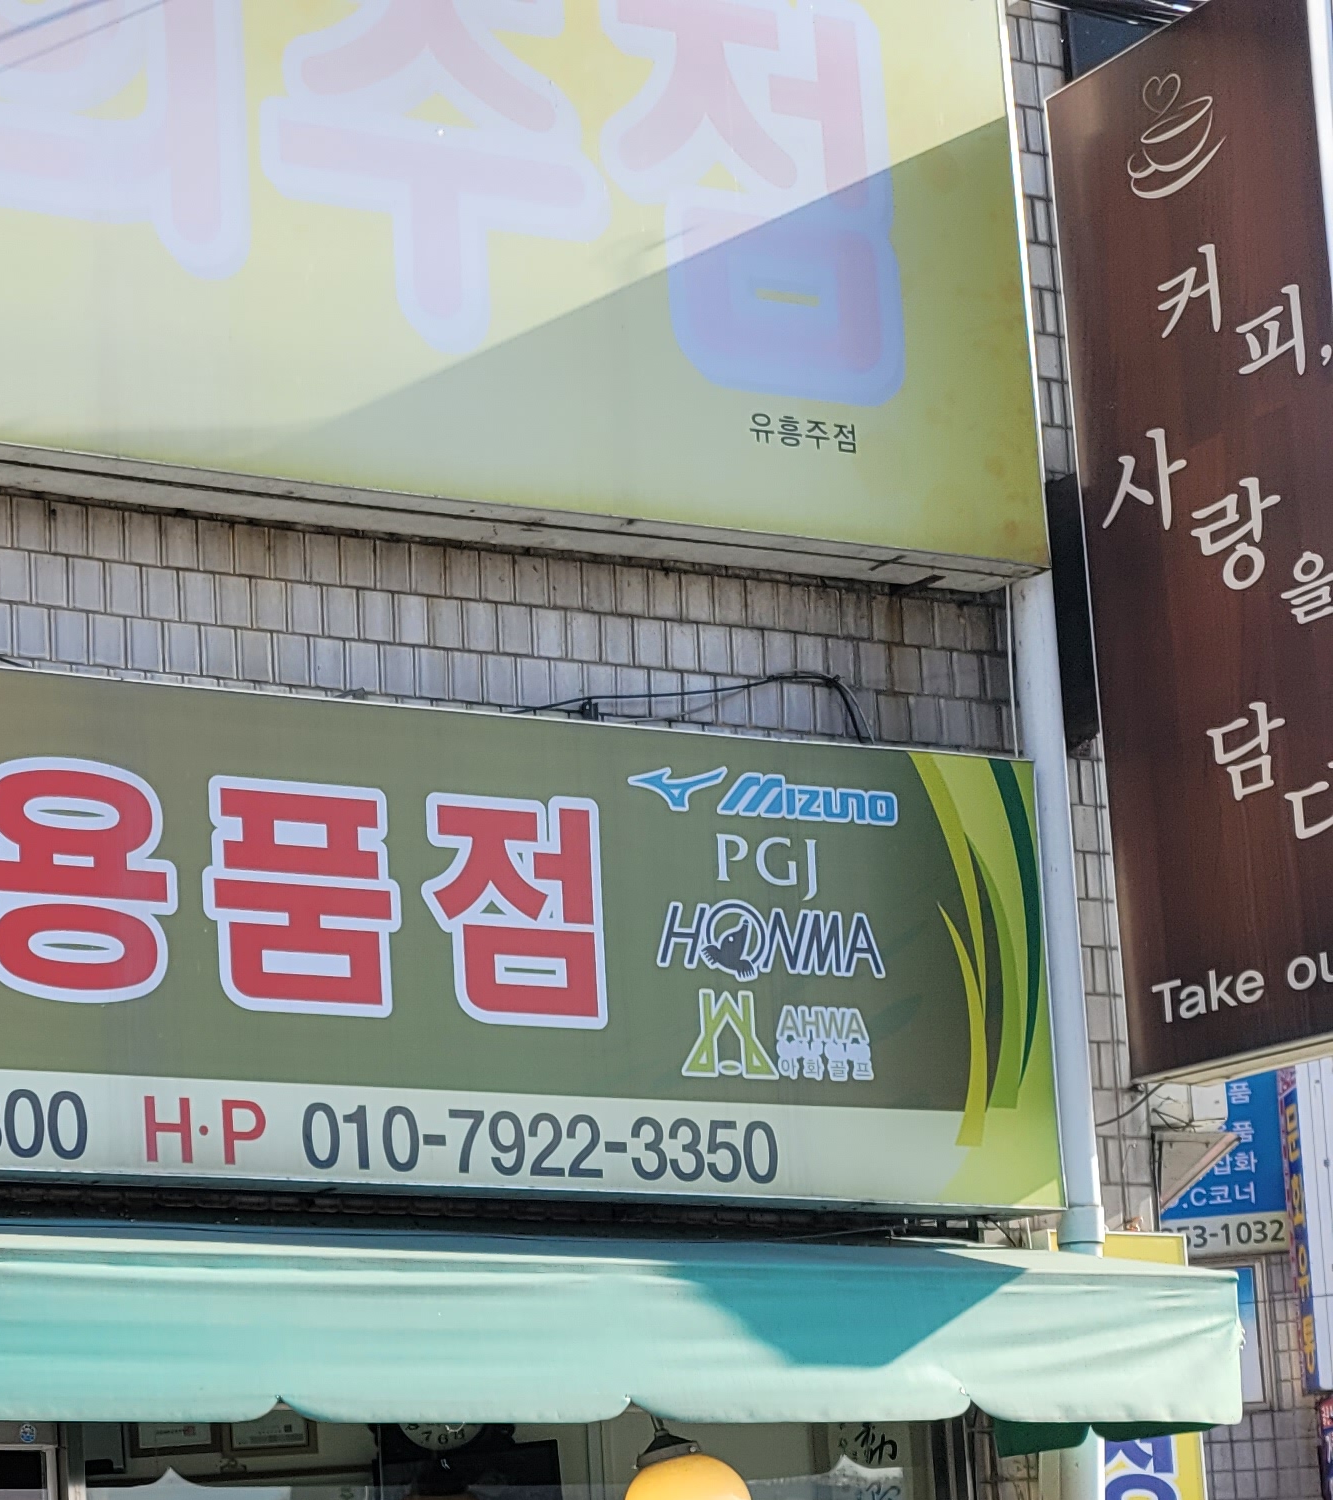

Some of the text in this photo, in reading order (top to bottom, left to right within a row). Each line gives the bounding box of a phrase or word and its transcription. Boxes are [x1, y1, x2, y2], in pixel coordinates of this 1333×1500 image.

[749, 412, 857, 454] 유흥주점
[1101, 427, 1333, 625] 사랑을
[716, 833, 818, 901] PGJ
[656, 899, 886, 981] HONMA
[777, 1005, 868, 1043] AHWA
[1151, 968, 1265, 1024] Take
[301, 1101, 779, 1185] 010-7922-3350
[1162, 1218, 1286, 1250] 53-1032
